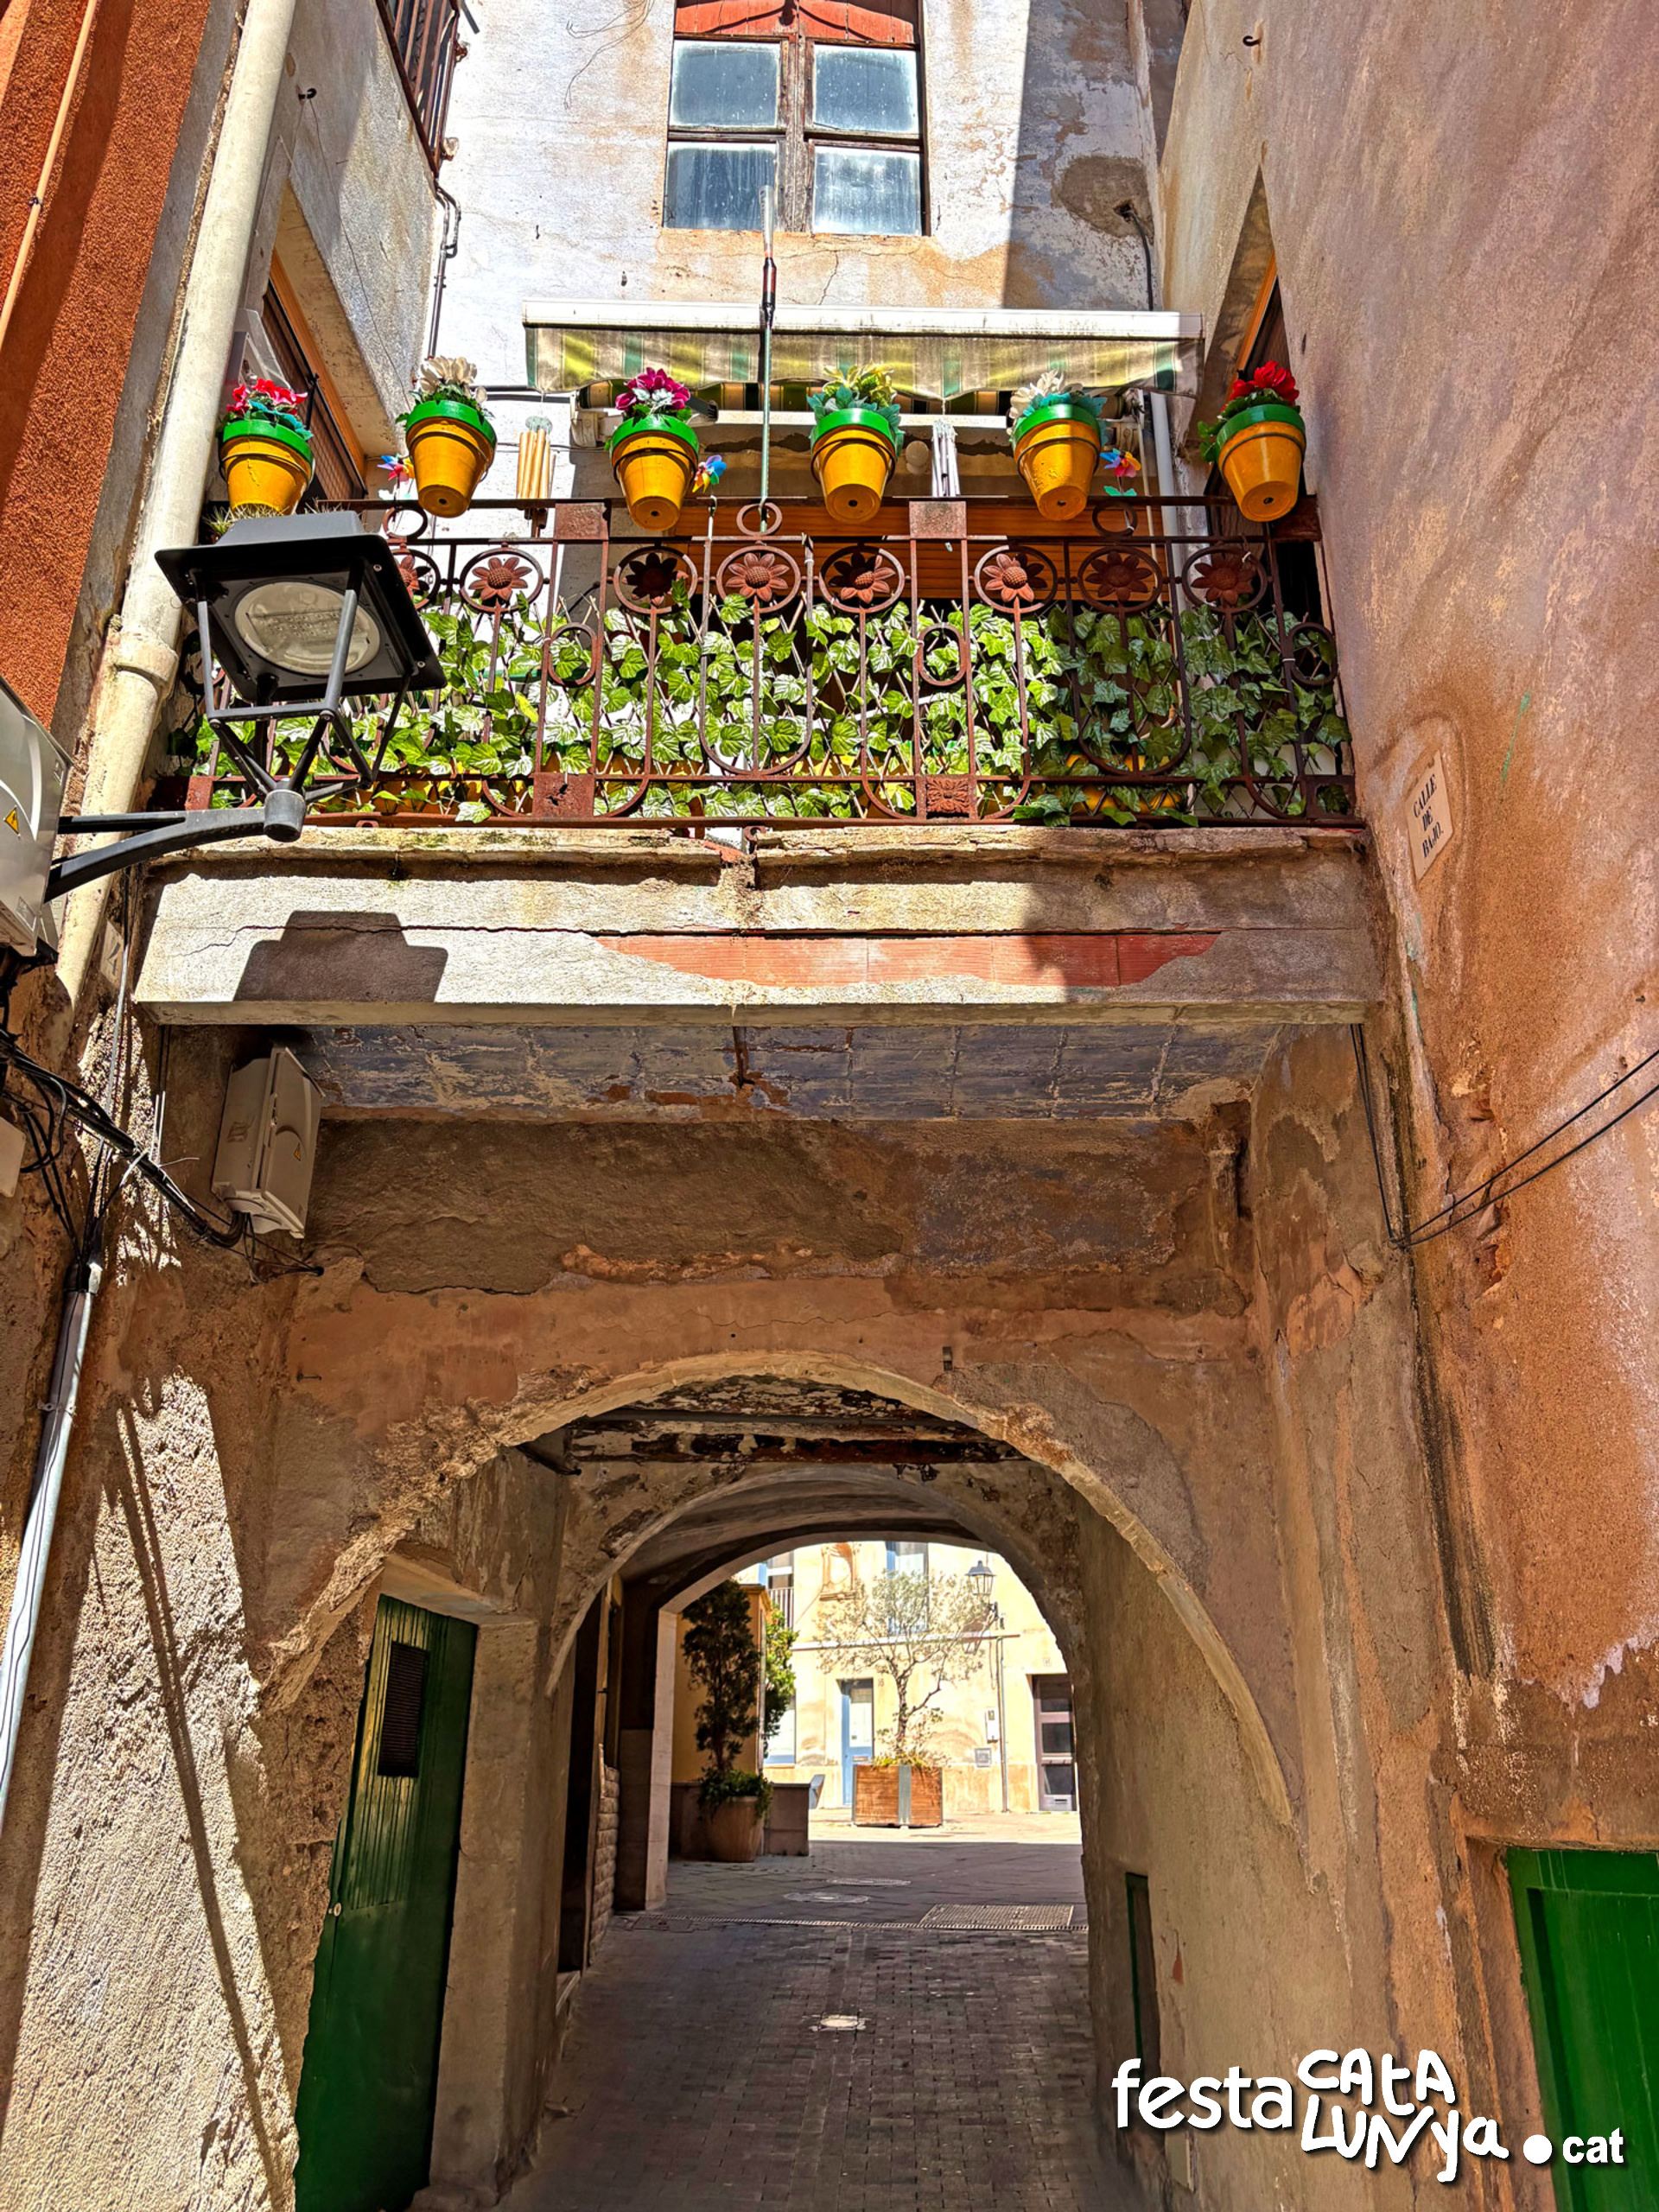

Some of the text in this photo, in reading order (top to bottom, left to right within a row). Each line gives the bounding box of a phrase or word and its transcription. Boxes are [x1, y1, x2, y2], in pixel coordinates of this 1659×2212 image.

[1413, 773, 1438, 818] CALLE
[1422, 805, 1433, 831] DE
[107, 942, 120, 976] 4
